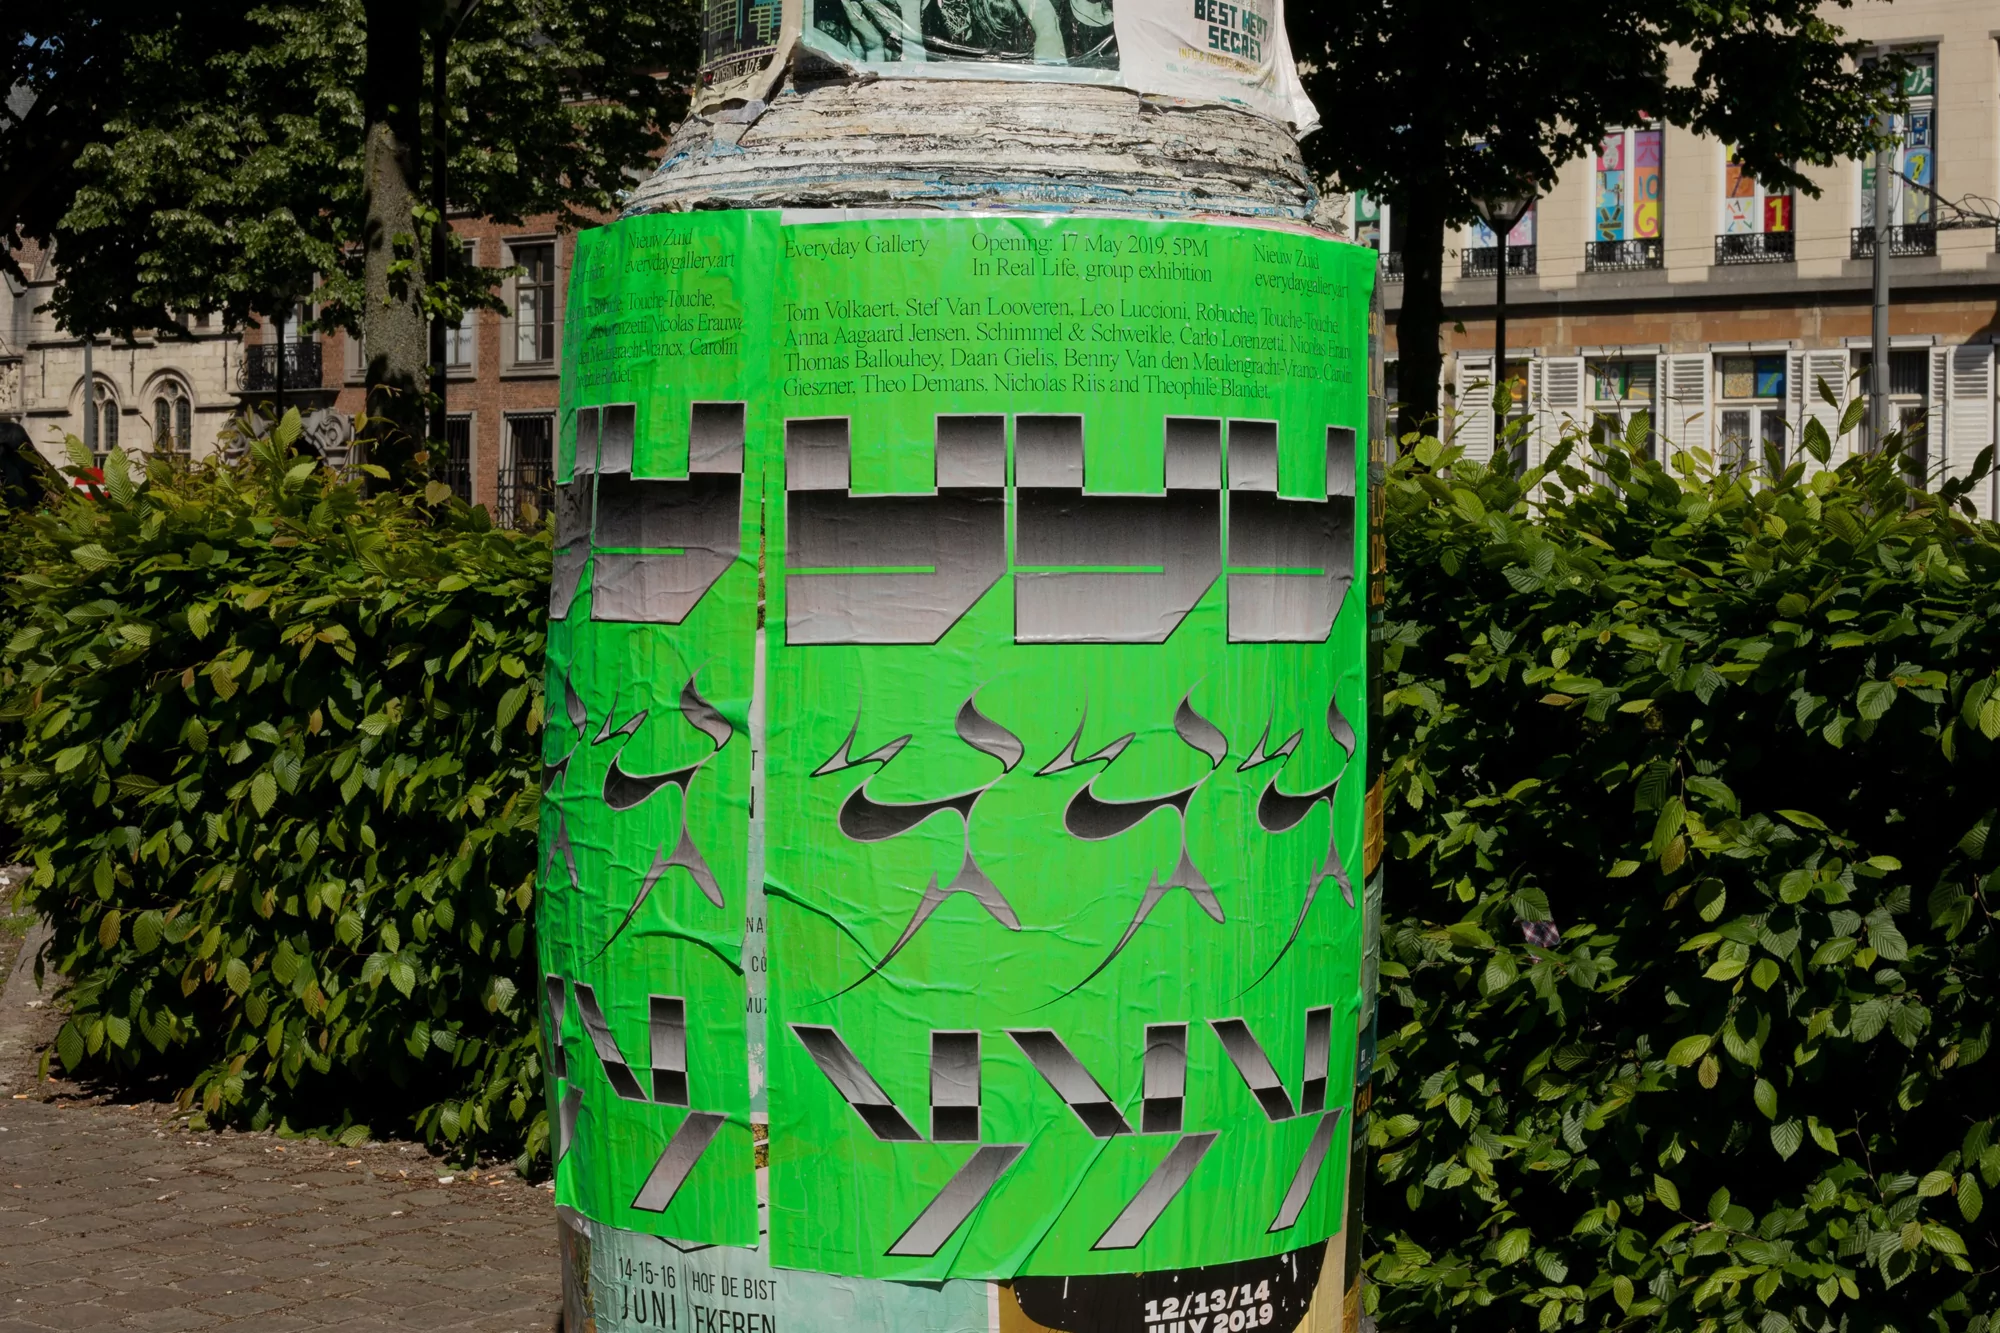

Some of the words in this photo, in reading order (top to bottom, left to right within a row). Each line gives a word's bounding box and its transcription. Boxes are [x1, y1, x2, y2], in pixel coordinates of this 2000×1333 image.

[1194, 0, 1238, 29] BEST
[1208, 25, 1262, 63] SECRET
[1769, 198, 1786, 232] 1
[628, 232, 661, 250] Nieuw
[662, 228, 694, 248] Zuid
[784, 236, 861, 262] Everyday
[865, 234, 931, 257] Gallery
[971, 232, 1053, 257] Opening:
[1062, 233, 1079, 252] 17
[1084, 234, 1123, 258] May
[1128, 234, 1168, 257] 2019,
[1172, 237, 1210, 258] 5PM
[625, 252, 736, 277] everydaygallery.art
[971, 257, 991, 277] In
[996, 257, 1036, 277] Real
[1041, 257, 1080, 279] Life,
[1085, 262, 1135, 284] group
[1138, 260, 1213, 284] exhibition
[1253, 243, 1293, 265] Nieuw
[1295, 249, 1320, 271] Zuid
[627, 289, 717, 312] Touche-Touche,
[783, 303, 820, 323] Tom
[825, 300, 900, 321] Volkaert,
[905, 297, 942, 318] Stef
[945, 296, 981, 316] Van
[987, 296, 1075, 318] Looveren,
[1080, 297, 1115, 317] Leo
[1120, 299, 1192, 322] Luccioni,
[1195, 301, 1258, 327] Robuche,
[650, 313, 695, 335] Nicolas
[690, 337, 739, 357] Carolin
[783, 327, 830, 348] Anna
[833, 324, 905, 350] Aagaard
[909, 322, 971, 344] Jensen,
[975, 321, 1063, 343] Schimmel
[1067, 322, 1087, 342] &
[1090, 323, 1176, 348] Schweikle,
[1179, 326, 1219, 347] Carlo
[1289, 334, 1326, 358] Nicolas
[783, 352, 850, 374] Thomas
[854, 349, 945, 374] Ballouhey,
[950, 347, 998, 368] Daan
[1003, 346, 1059, 369] Gielis,
[1064, 347, 1121, 373] Benny
[1125, 349, 1158, 370] Van
[1161, 350, 1189, 371] den
[783, 375, 857, 399] Gieszner,
[861, 373, 907, 394] Theo
[911, 373, 989, 395] Demans,
[993, 372, 1067, 393] Nicholas
[1071, 373, 1106, 393] Riis
[1109, 374, 1140, 394] and
[1143, 374, 1218, 400] Theophile
[1218, 377, 1272, 401] Blandet.
[618, 1256, 676, 1289] 14-15-16
[692, 1270, 716, 1294] HOF
[721, 1275, 738, 1298] DE
[744, 1279, 777, 1301] BIST
[621, 1285, 677, 1331] JUNI
[1144, 1279, 1271, 1323] 12/13/14
[1212, 1303, 1274, 1333] 2019
